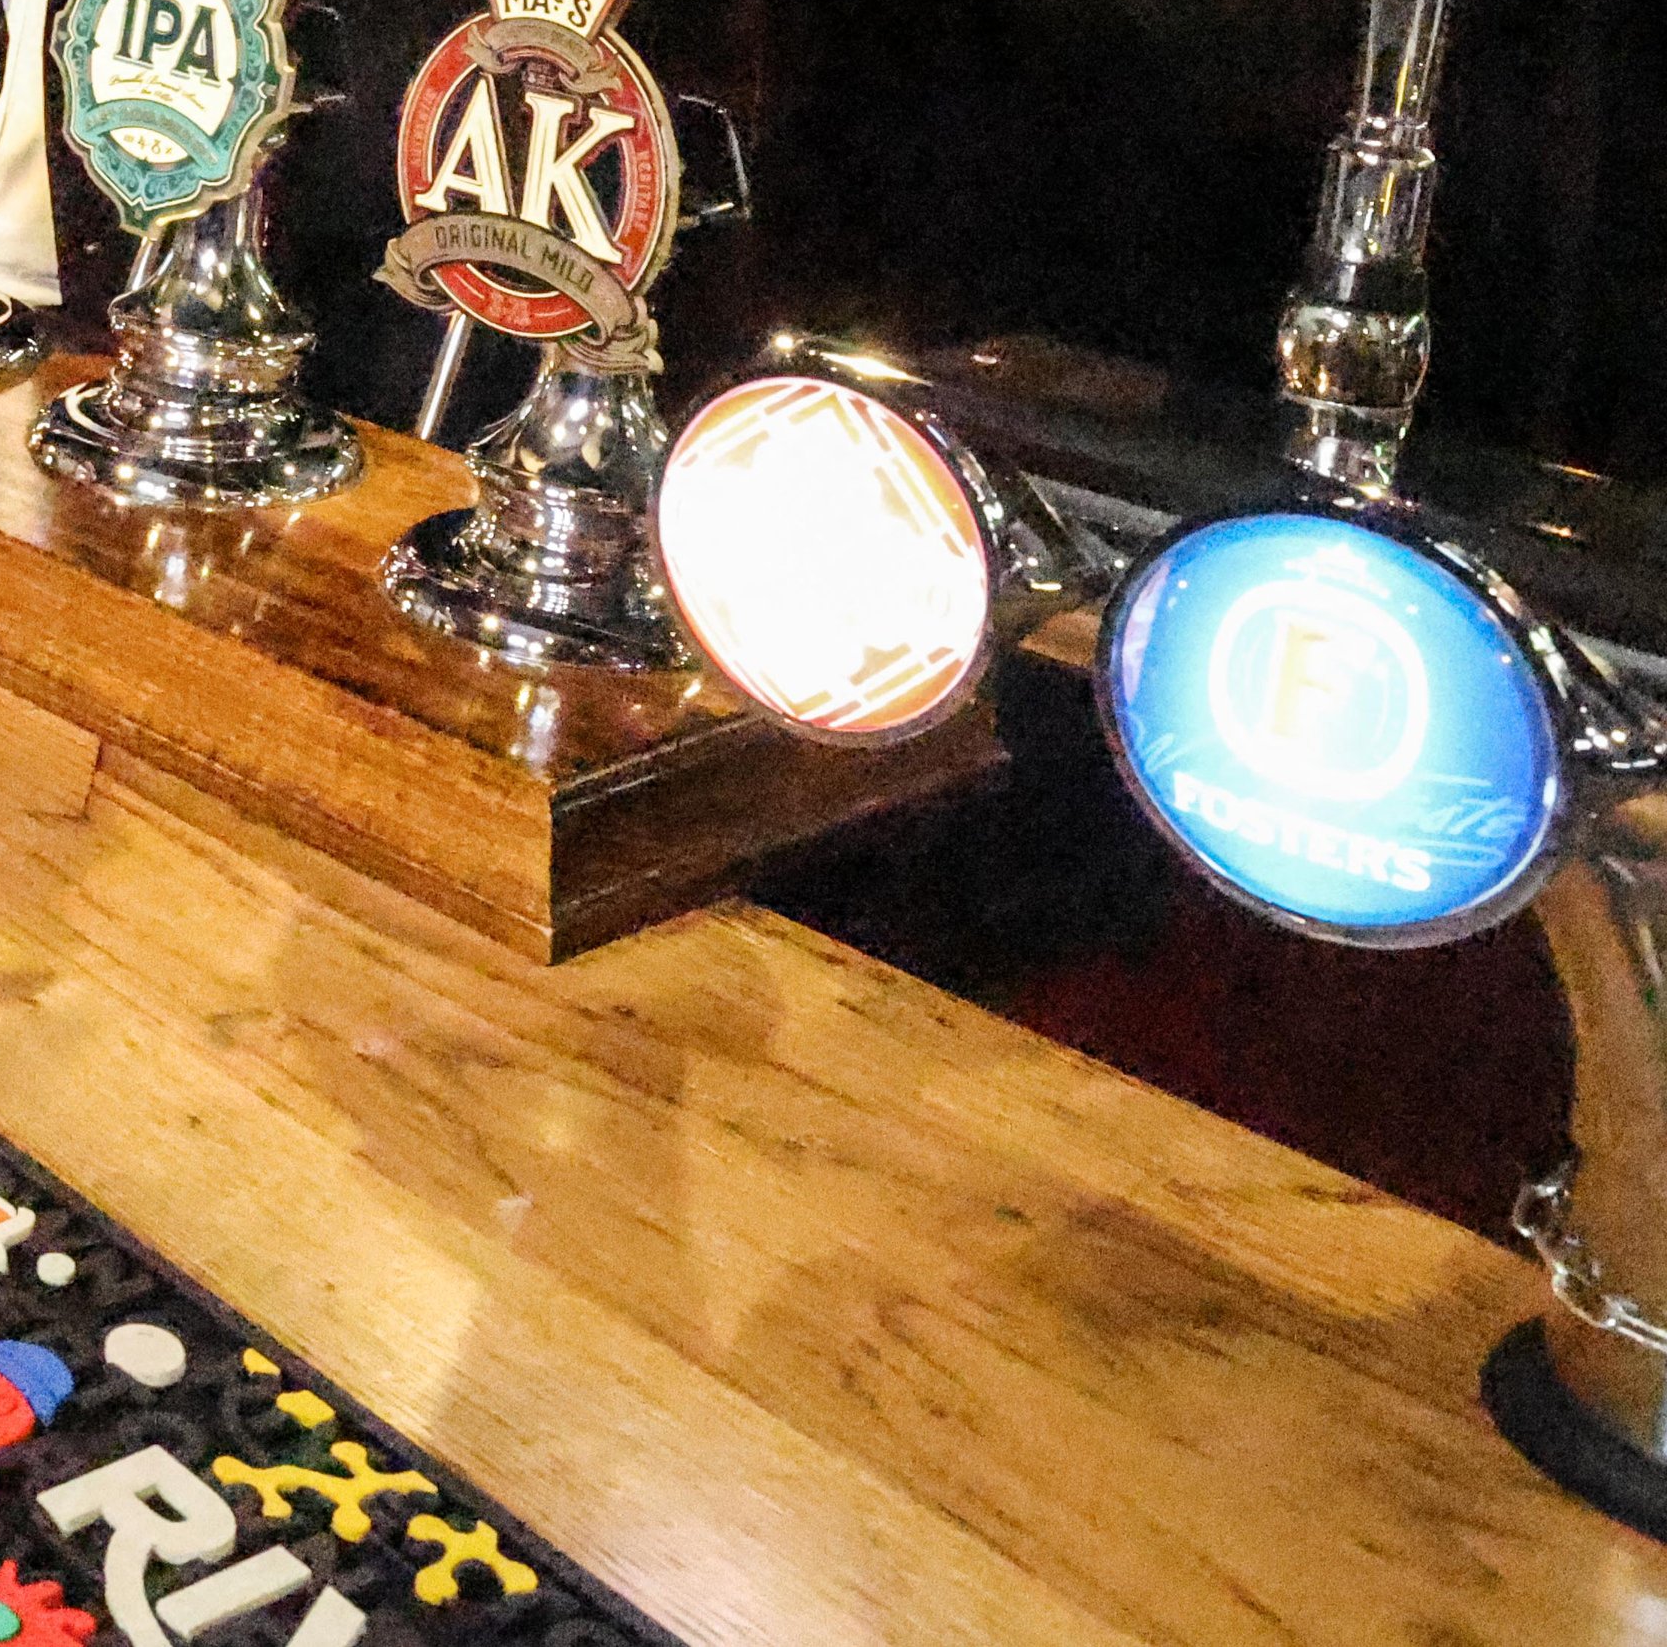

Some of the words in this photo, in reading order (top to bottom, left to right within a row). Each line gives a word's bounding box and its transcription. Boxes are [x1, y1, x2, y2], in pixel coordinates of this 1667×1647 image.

[414, 74, 636, 265] AK
[434, 224, 534, 258] ORIGINAL
[539, 243, 596, 294] MILD
[36, 1443, 368, 1647] RI
